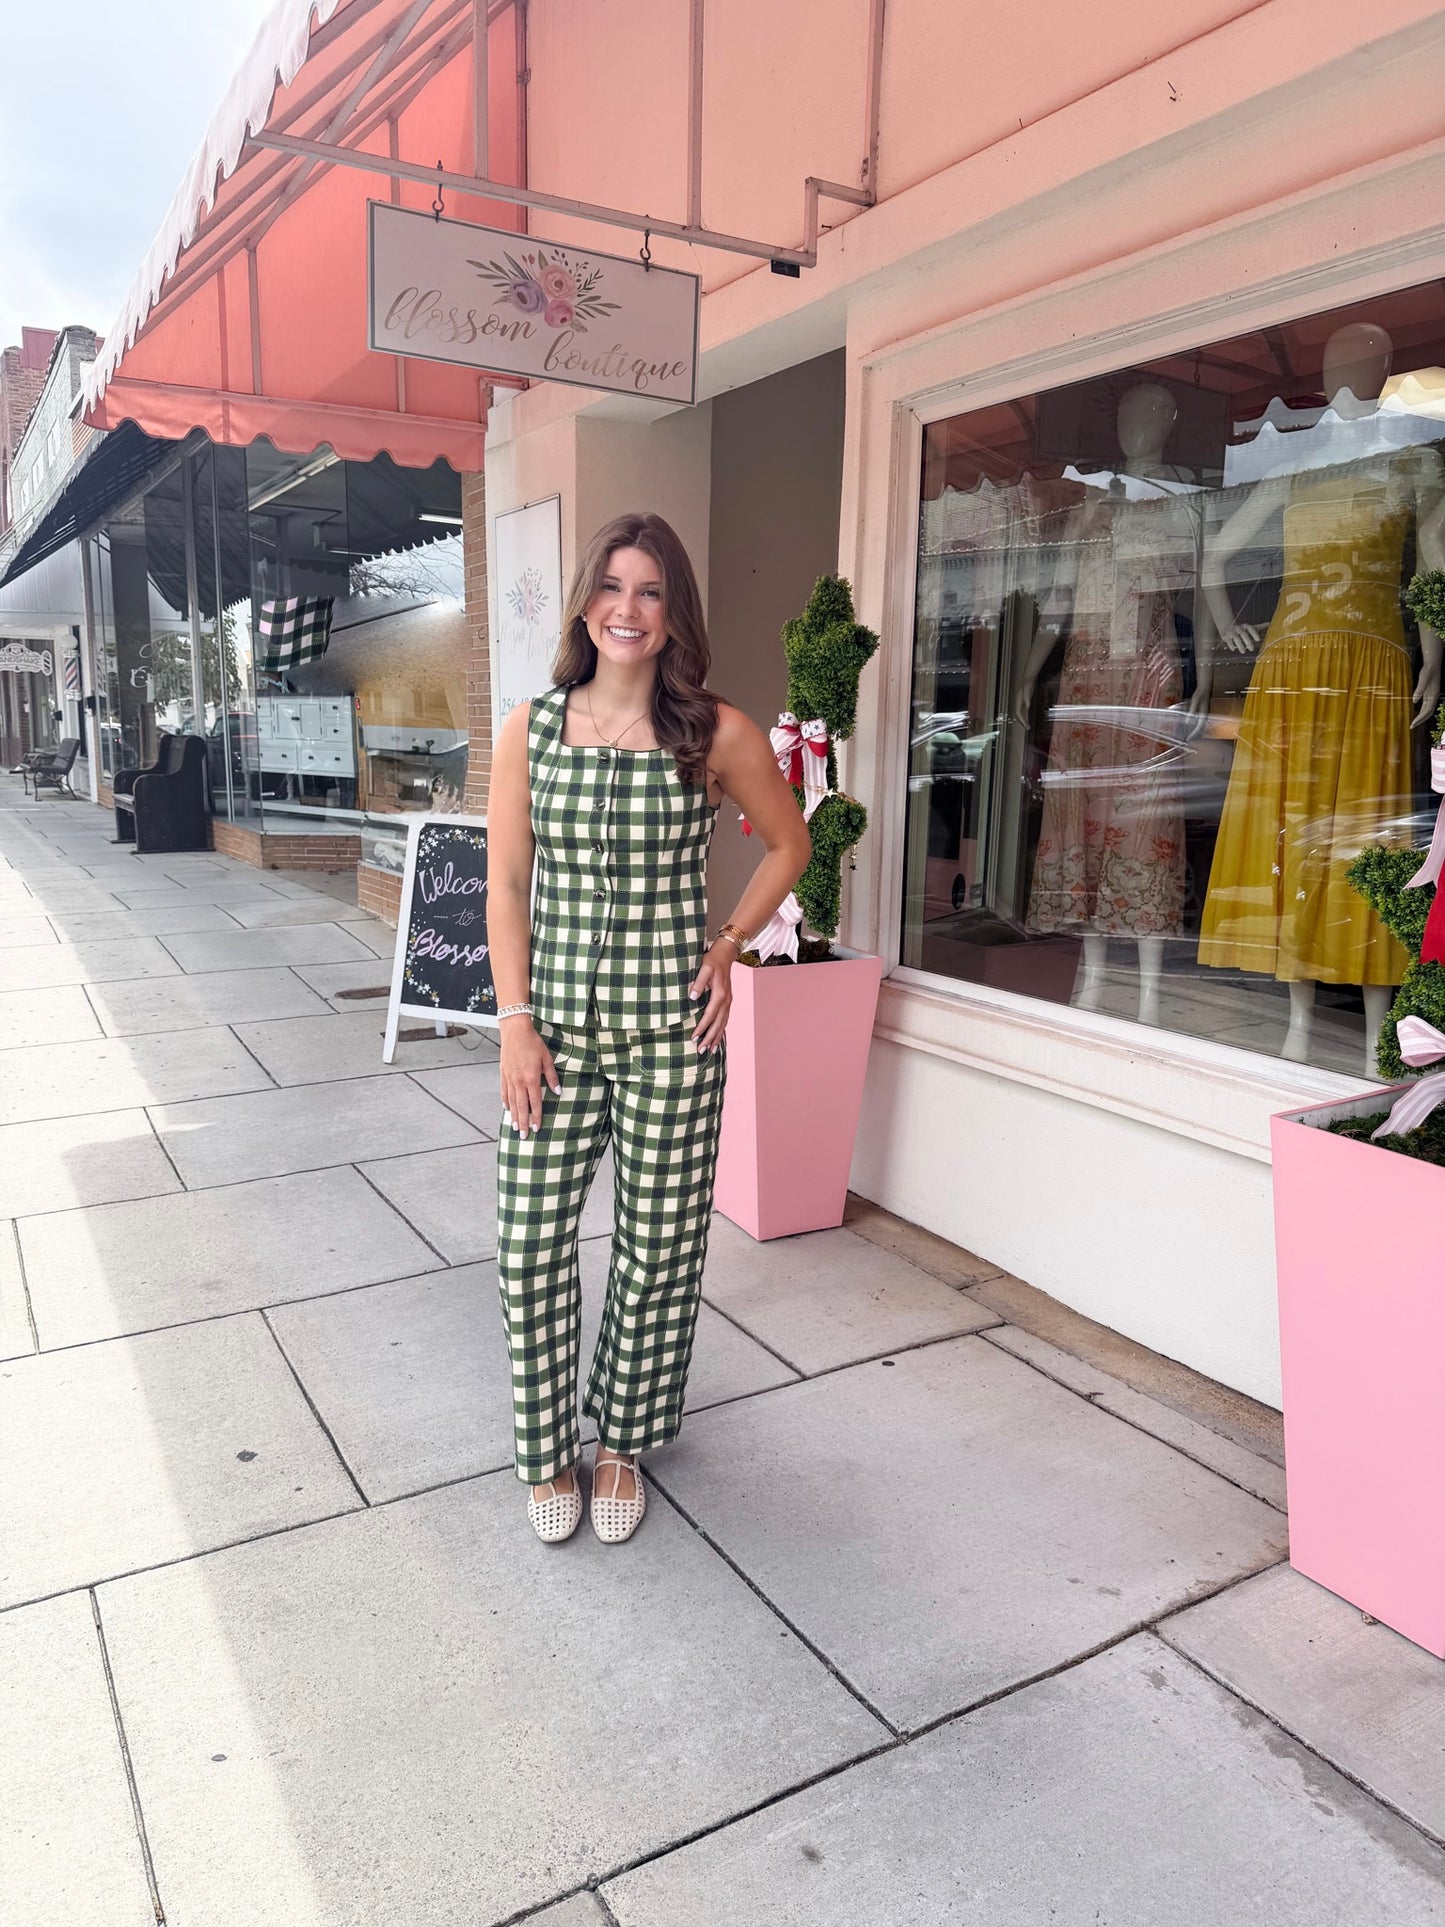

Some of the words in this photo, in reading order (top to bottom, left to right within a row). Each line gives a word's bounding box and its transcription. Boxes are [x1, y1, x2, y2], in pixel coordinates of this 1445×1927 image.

[385, 287, 535, 343] blossom
[544, 331, 687, 389] boutique
[452, 908, 482, 926] to
